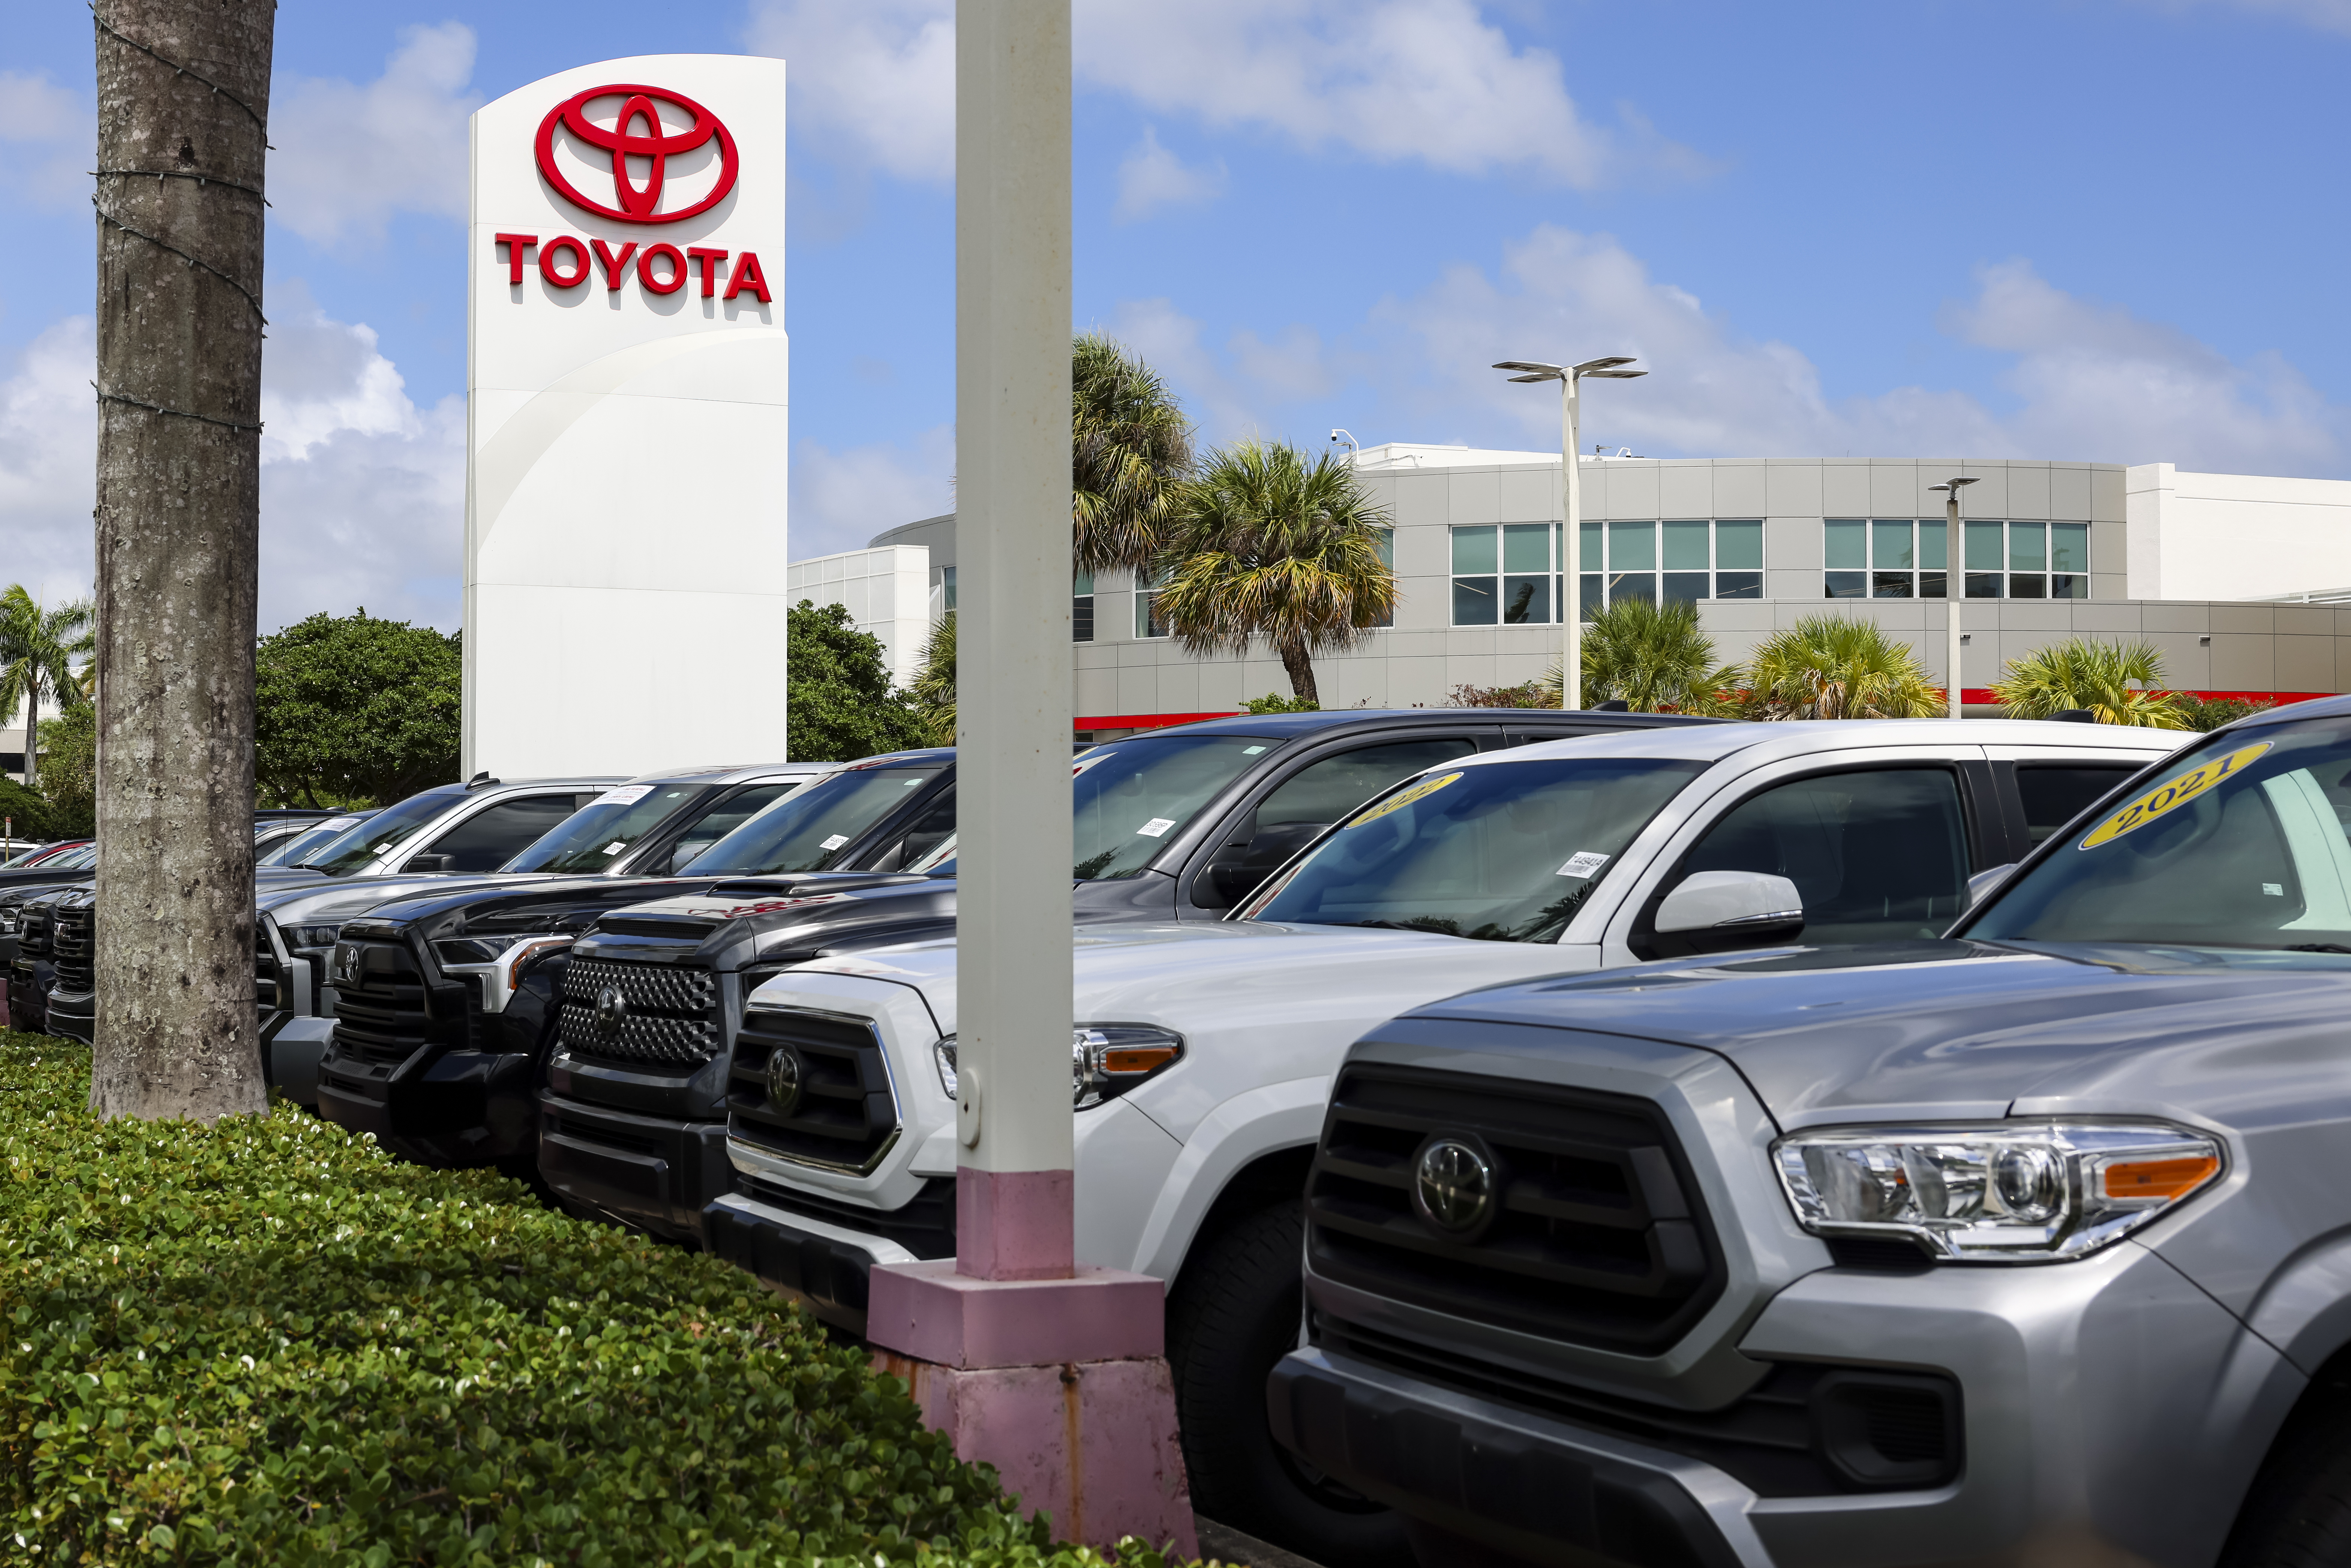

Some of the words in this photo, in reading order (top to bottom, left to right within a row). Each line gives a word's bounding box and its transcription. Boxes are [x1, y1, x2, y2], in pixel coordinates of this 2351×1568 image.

[495, 232, 772, 303] TOYOTA
[1360, 778, 1445, 823] 2022
[2114, 755, 2235, 834] 2021
